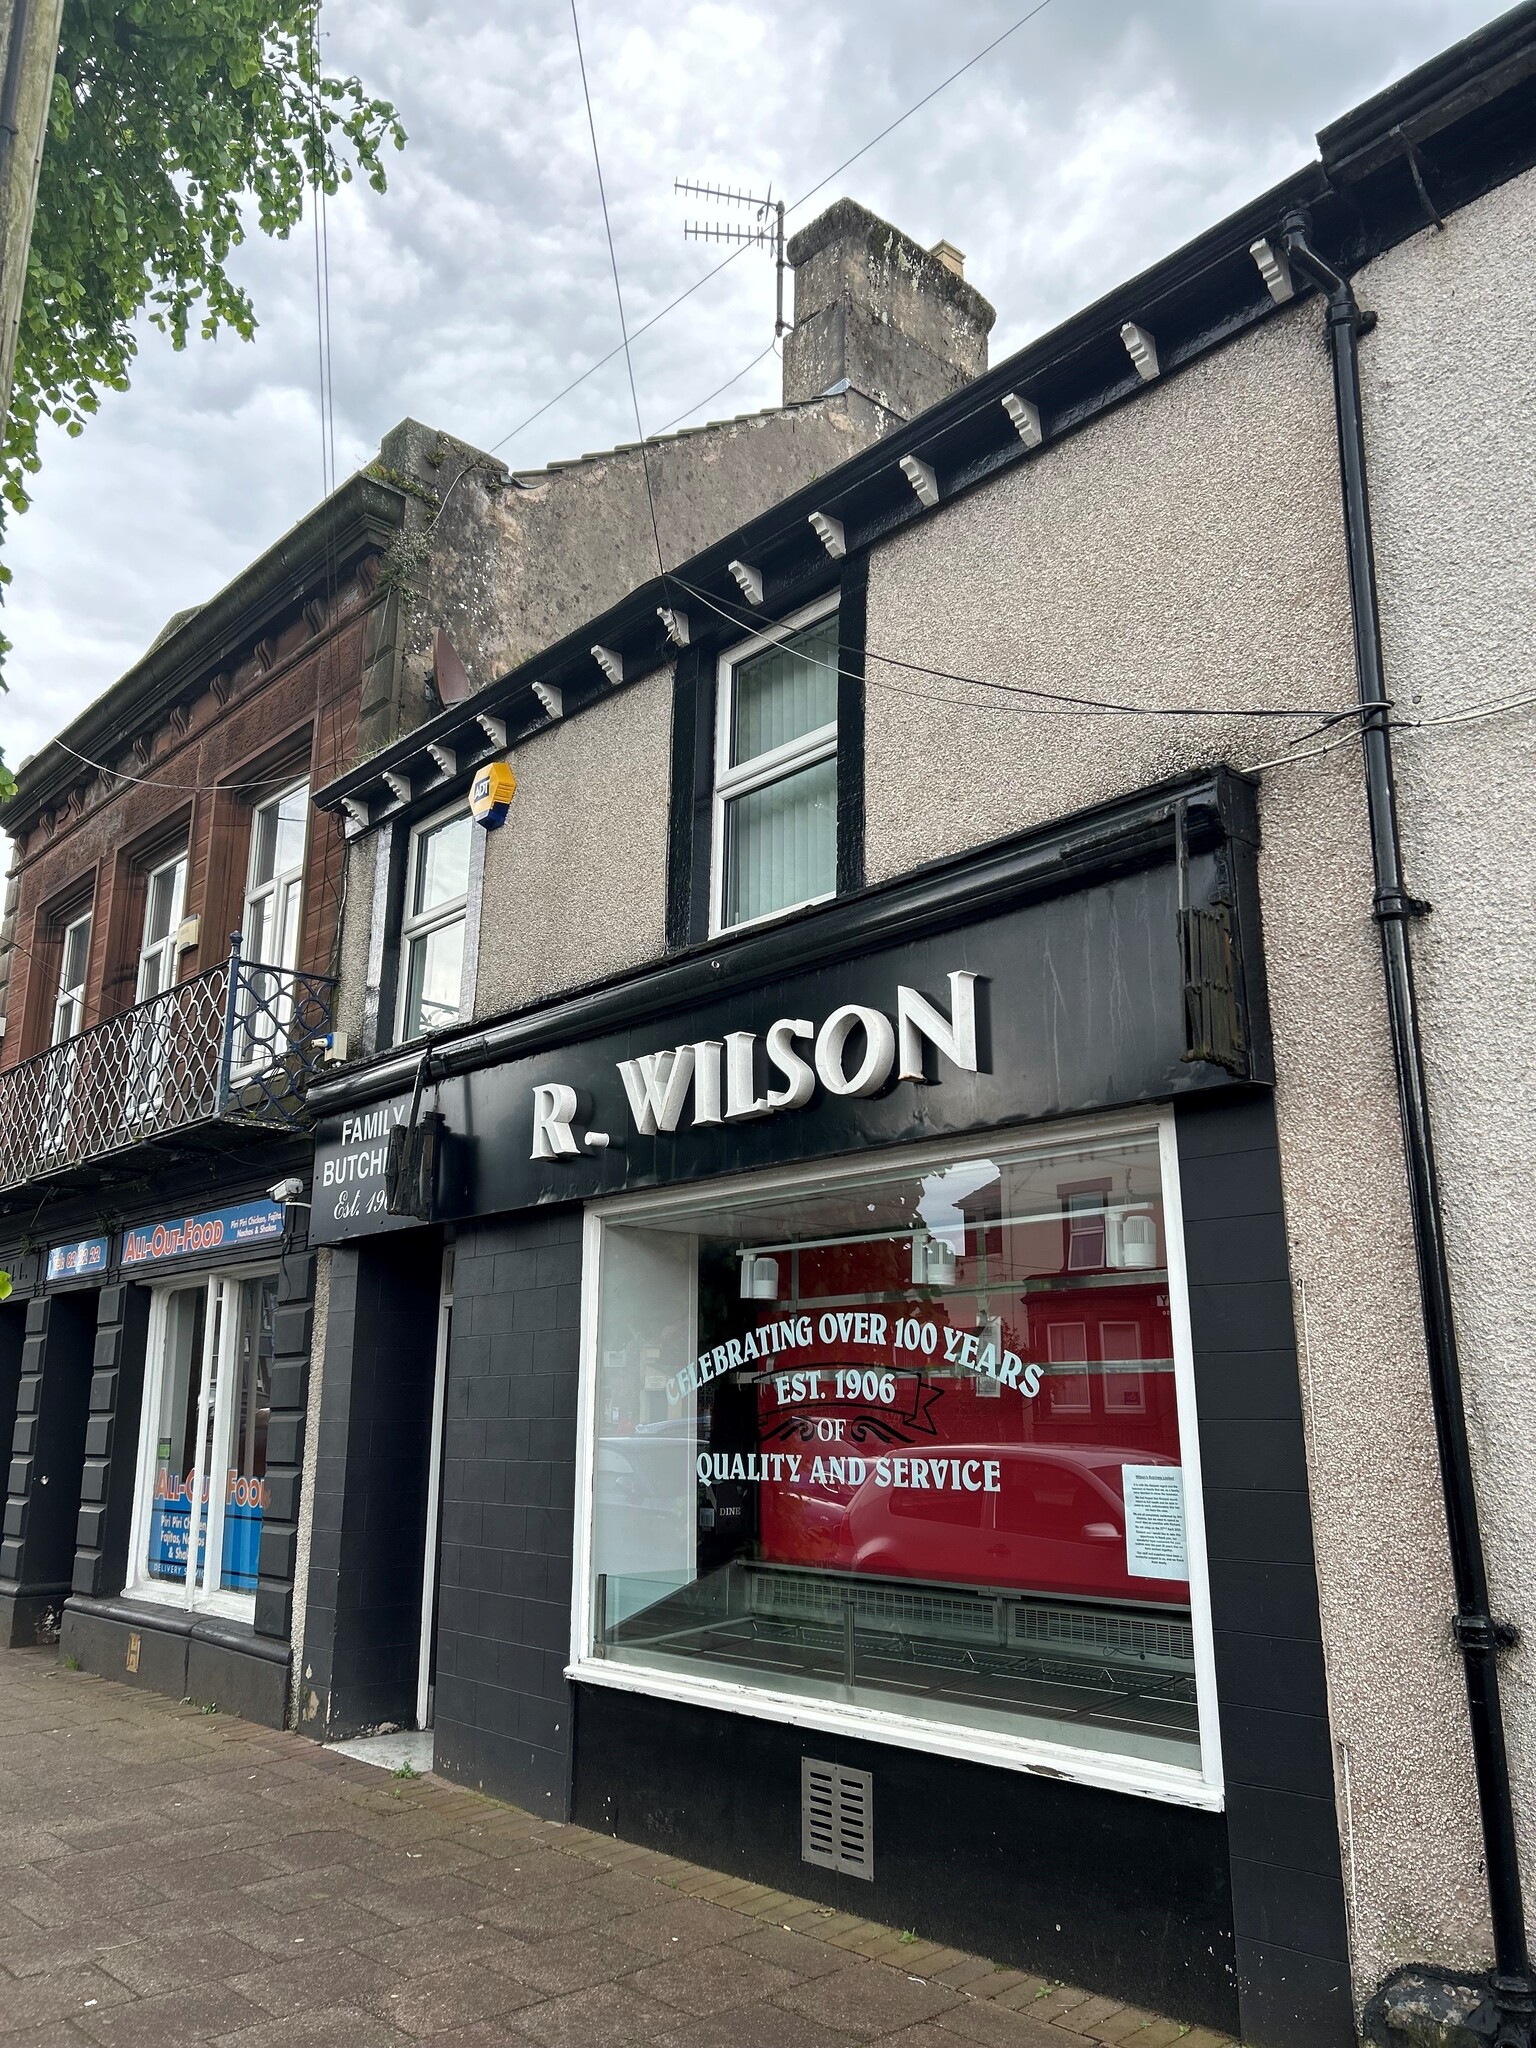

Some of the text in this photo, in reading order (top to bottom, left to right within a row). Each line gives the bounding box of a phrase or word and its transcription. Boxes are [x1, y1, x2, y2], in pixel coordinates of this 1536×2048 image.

[474, 779, 490, 799] ADT
[529, 969, 979, 1161] R. WILSON
[342, 1105, 405, 1146] FAMILY
[323, 1147, 388, 1187] BUTCH
[334, 1189, 360, 1220] Est.
[666, 1312, 1045, 1406] CELEBRATING OVER 100 YEARS
[776, 1368, 896, 1406] EST. 1906
[817, 1418, 846, 1442] OF
[696, 1452, 1001, 1492] QUALITY AND SERVICE
[161, 1515, 171, 1528] Piri
[172, 1515, 183, 1529] Piri
[719, 1506, 741, 1516] DINE
[168, 1546, 174, 1559] &
[153, 1563, 182, 1574] DELIVERY
